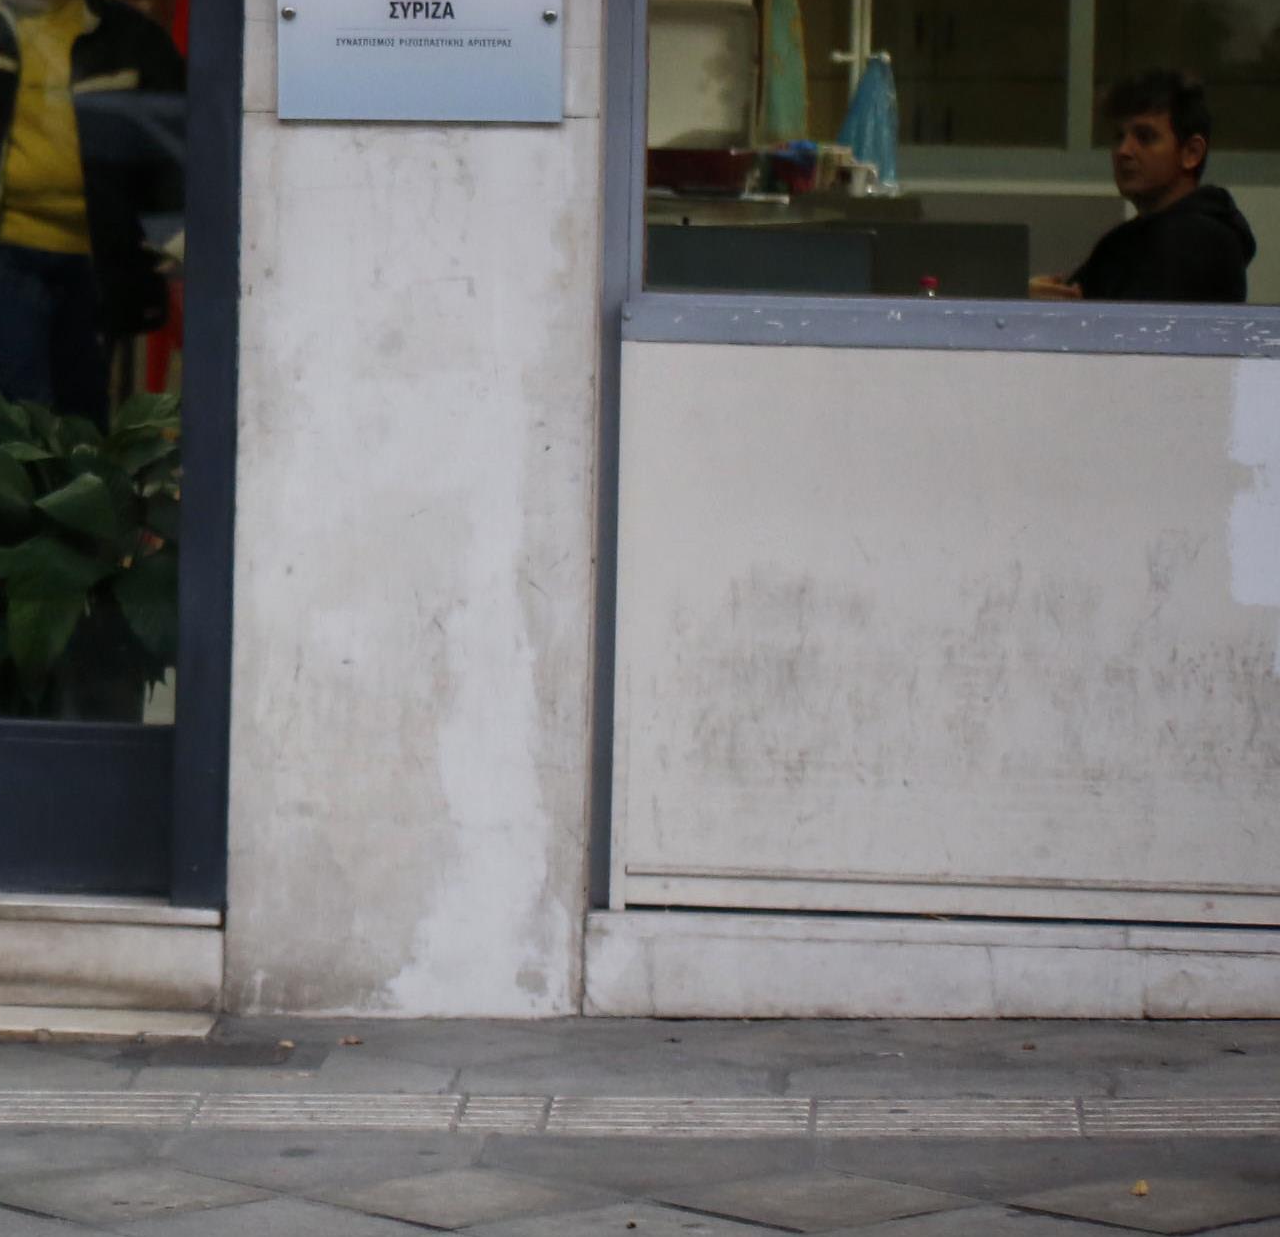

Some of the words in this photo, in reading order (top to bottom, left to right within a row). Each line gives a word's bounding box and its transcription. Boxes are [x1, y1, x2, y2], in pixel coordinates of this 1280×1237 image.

[389, 1, 455, 20] ΣΥΡΙΖΑ
[336, 37, 395, 47] ΣΥΝΑΣΠΙΣΜΟΣ
[399, 38, 464, 47] ΡΙΖΟΣΠΑΣΤΙΚΗΣ
[467, 38, 512, 48] ΑΡΙΣΤΕΡΑΣ
